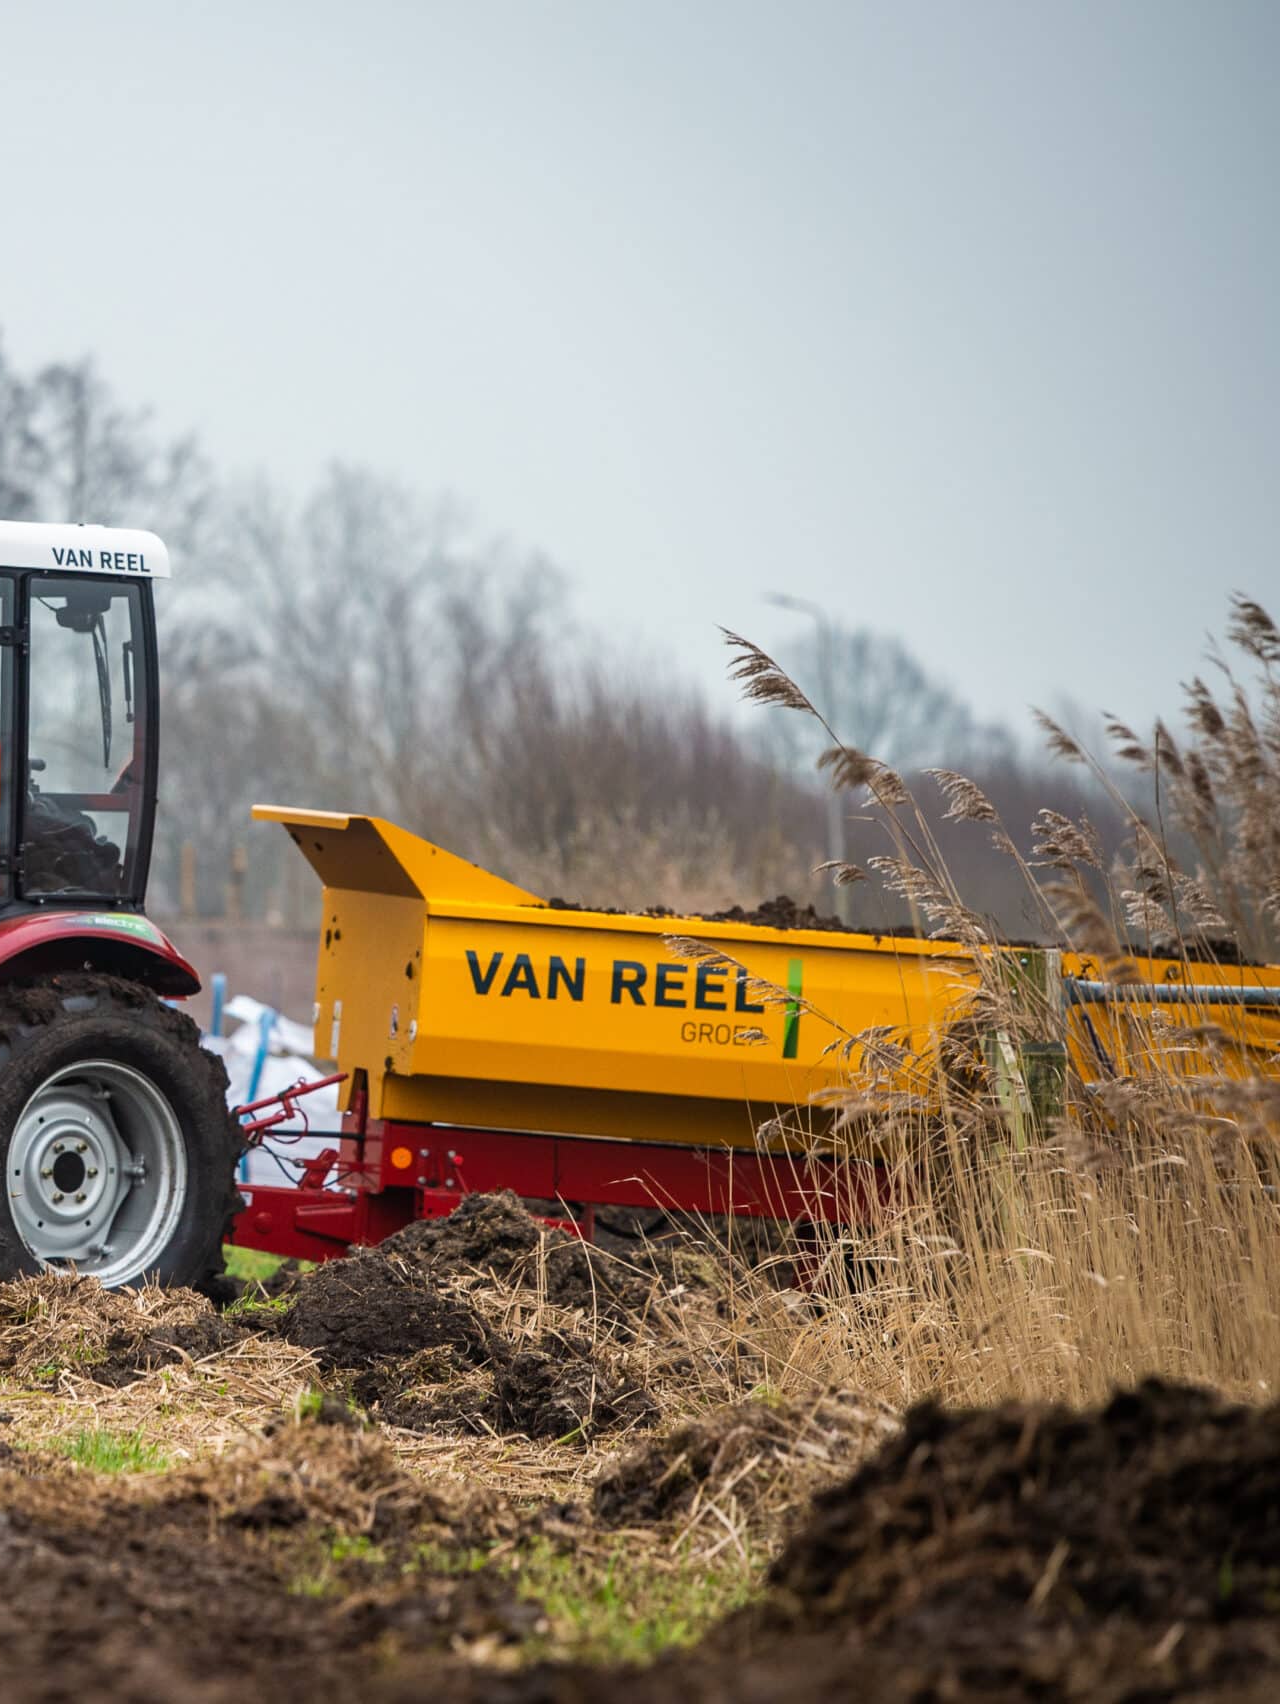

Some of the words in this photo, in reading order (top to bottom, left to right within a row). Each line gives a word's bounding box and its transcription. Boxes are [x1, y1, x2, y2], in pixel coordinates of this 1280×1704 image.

[52, 547, 92, 568] VAN
[100, 551, 150, 572] REEL
[466, 950, 585, 1001] VAN
[610, 960, 765, 1013] REEL
